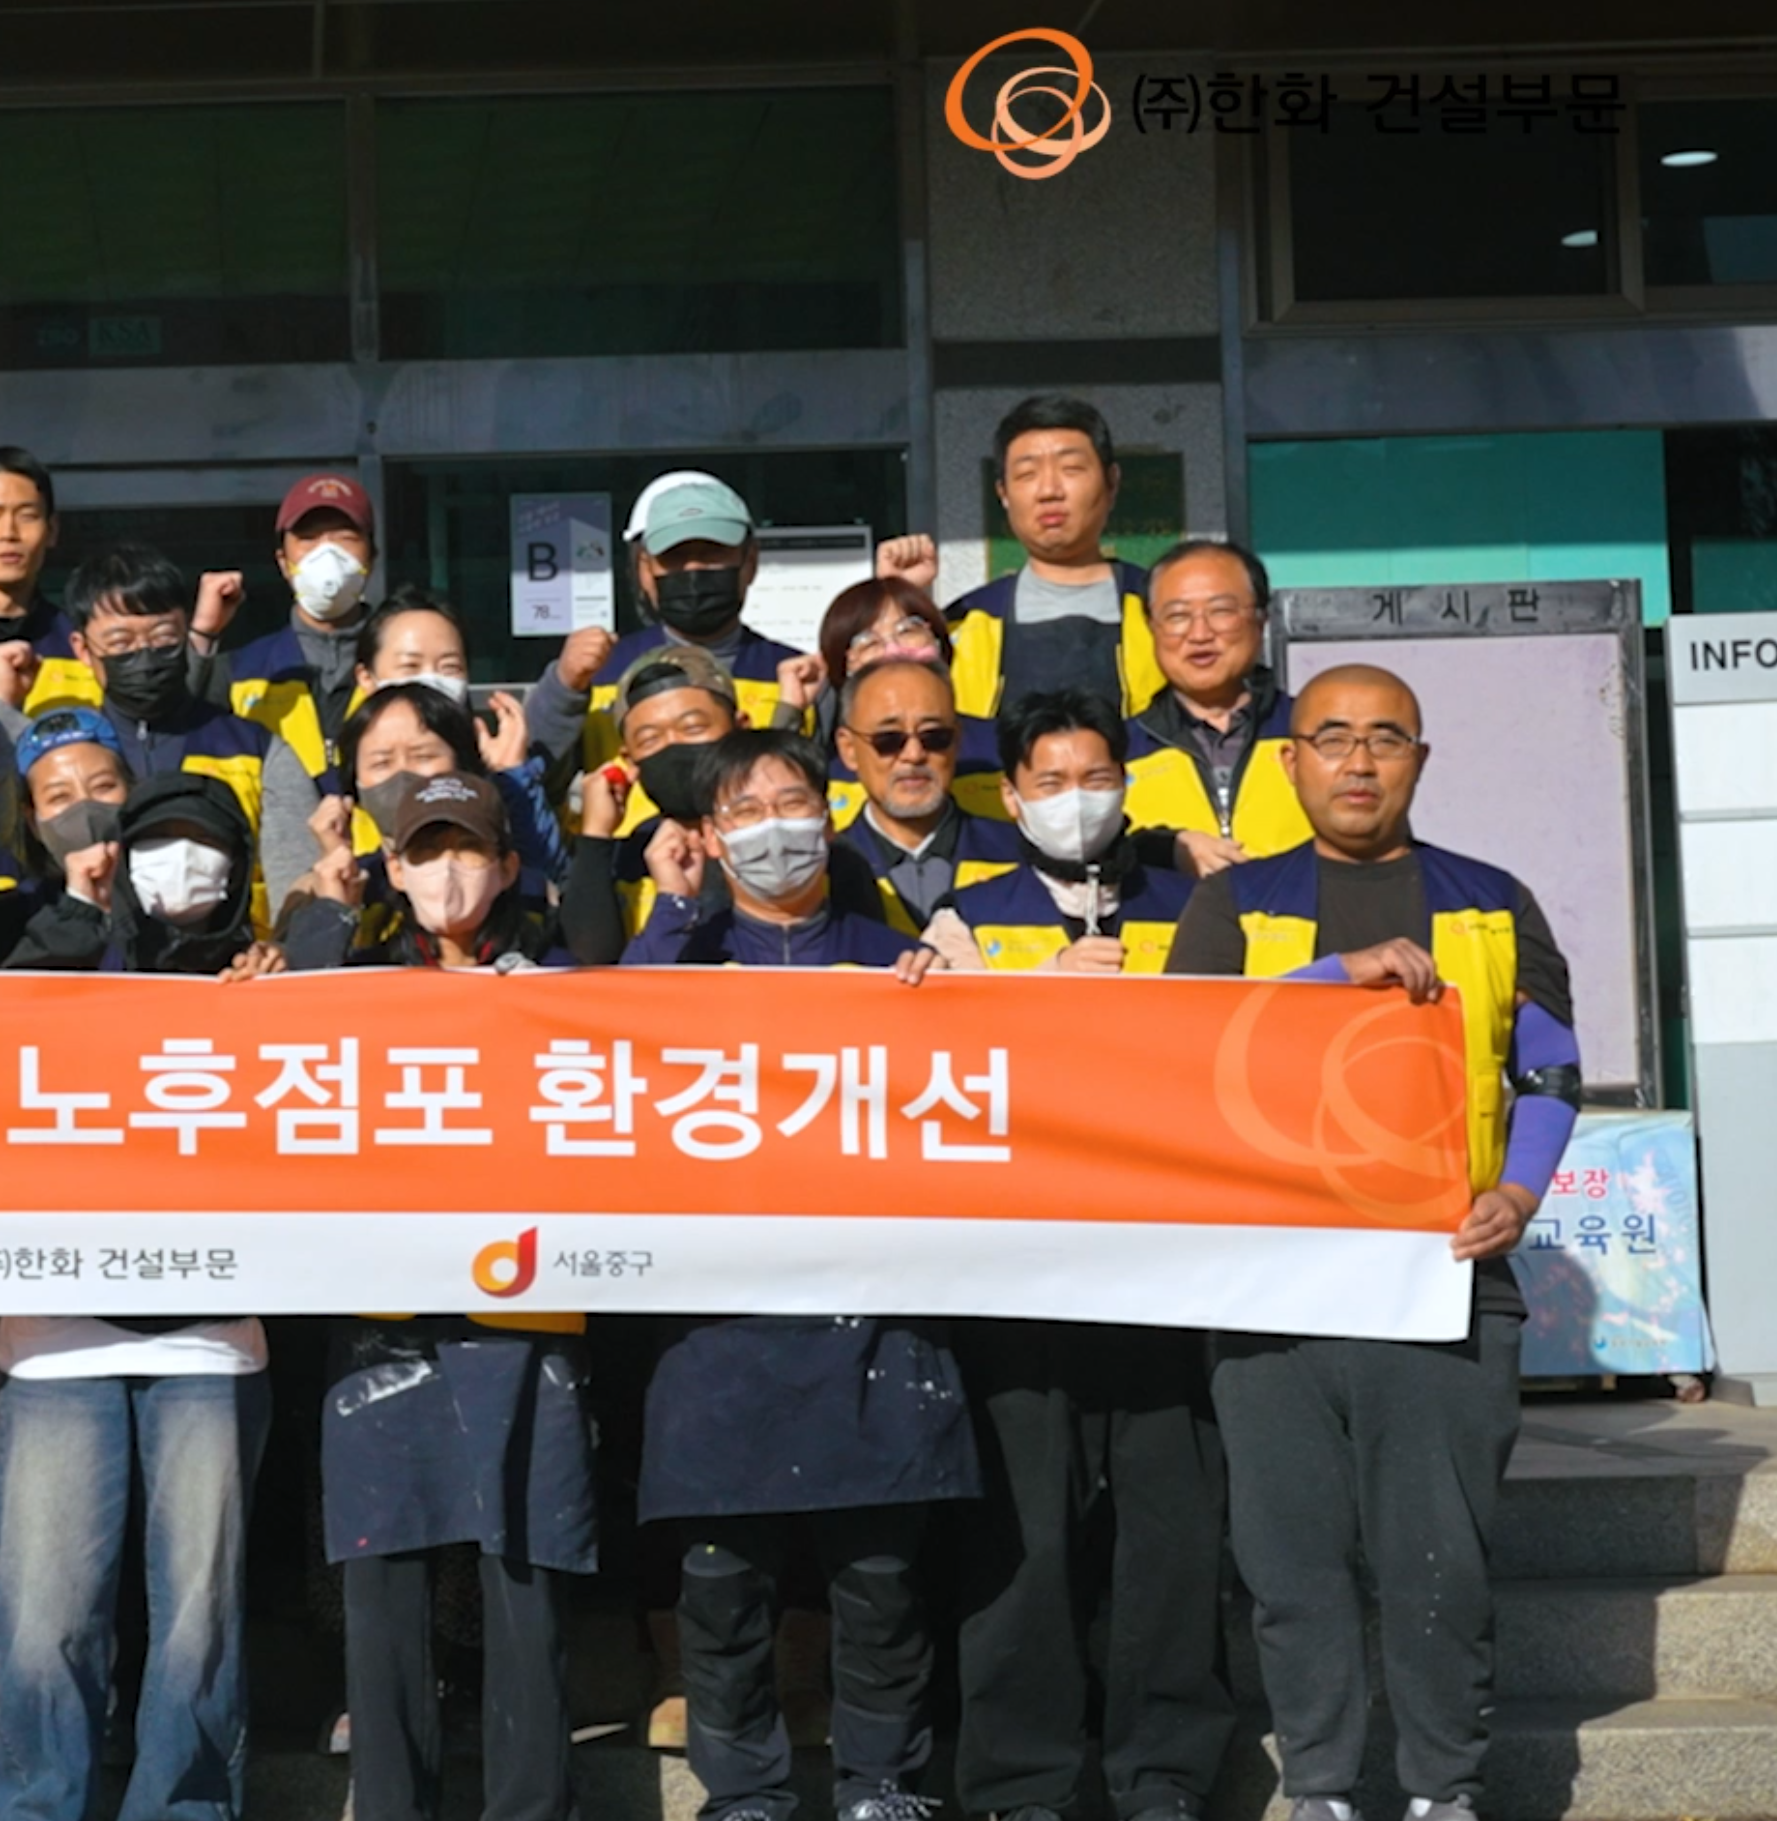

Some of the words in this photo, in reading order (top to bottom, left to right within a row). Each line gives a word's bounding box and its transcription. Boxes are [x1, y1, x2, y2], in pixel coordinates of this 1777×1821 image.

[528, 541, 559, 582] B
[1371, 588, 1541, 626] 게시판
[1691, 638, 1777, 671] INFO
[7, 1037, 494, 1157] 노후점포
[529, 1040, 1013, 1163] 환경개선
[1528, 1214, 1656, 1256] 교육원
[99, 1248, 238, 1280] 건설부문
[554, 1251, 654, 1278] 서울중구
